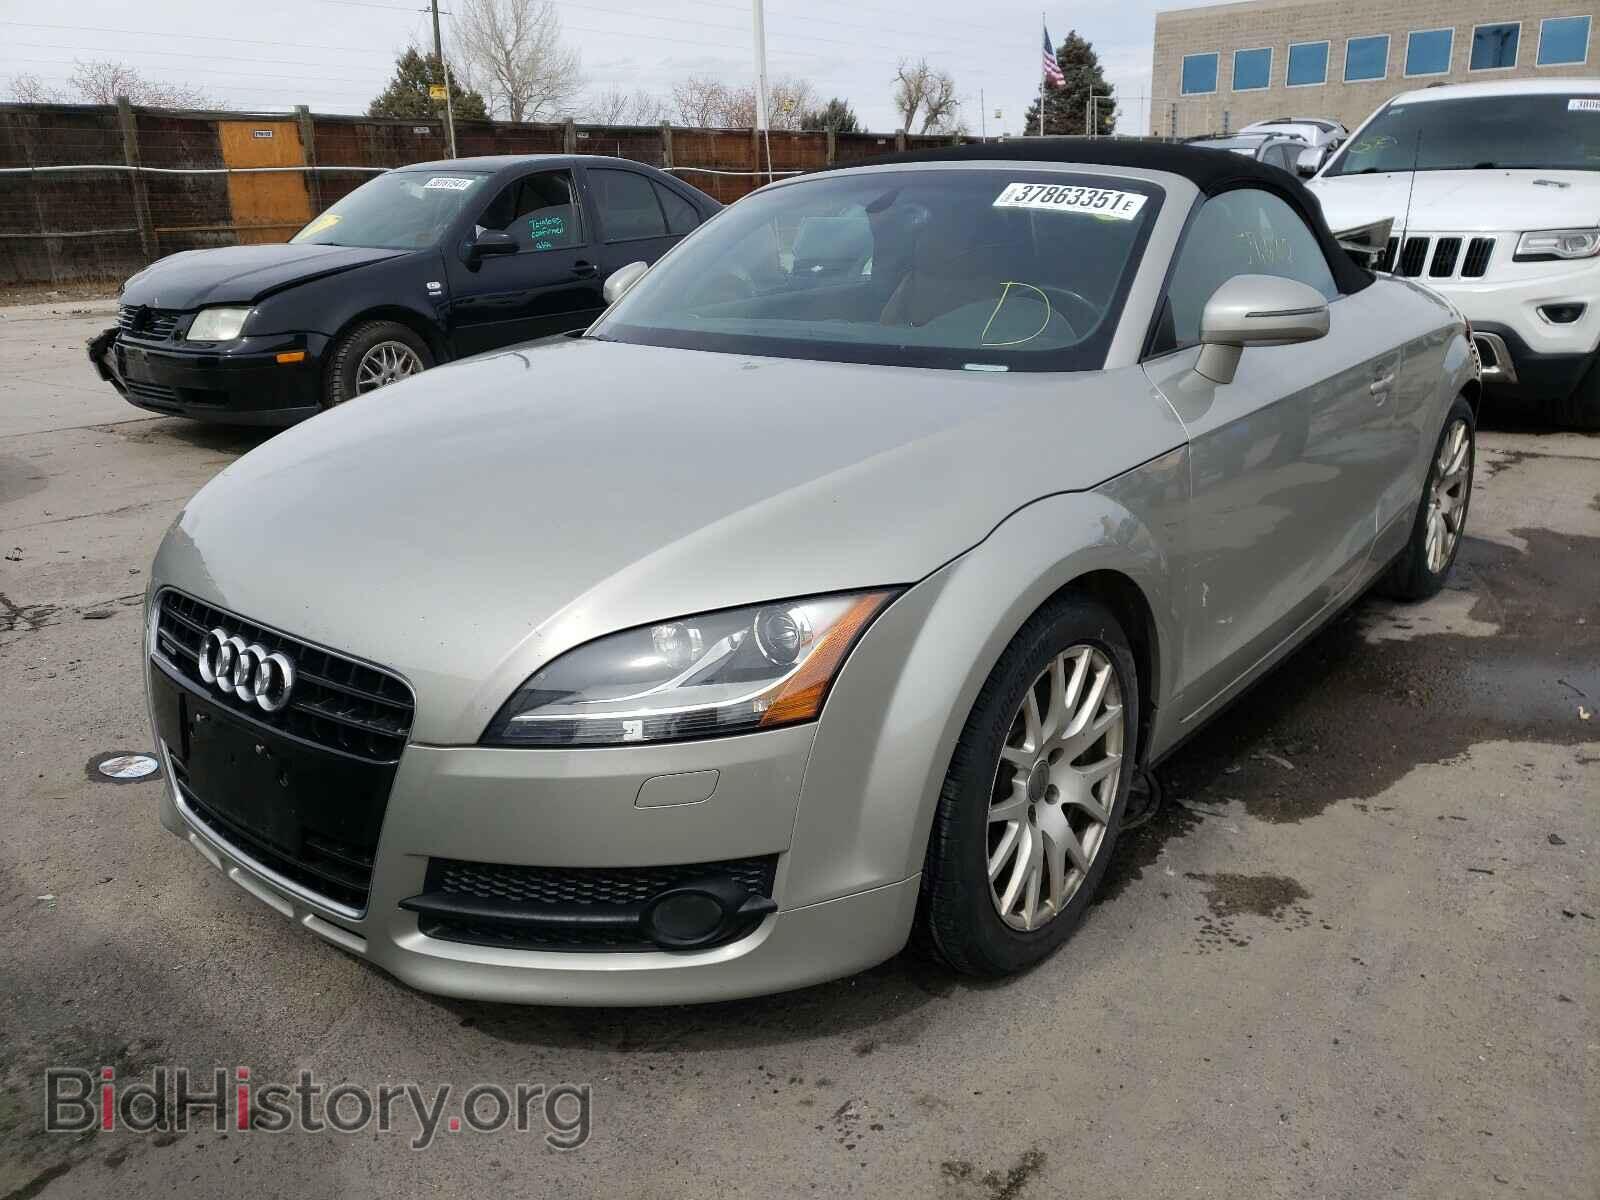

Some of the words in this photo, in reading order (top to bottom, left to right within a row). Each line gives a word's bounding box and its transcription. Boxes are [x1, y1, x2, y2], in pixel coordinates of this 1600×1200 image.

[1014, 185, 1124, 210] 37863351
[1122, 200, 1134, 211] E
[981, 281, 1051, 346] D
